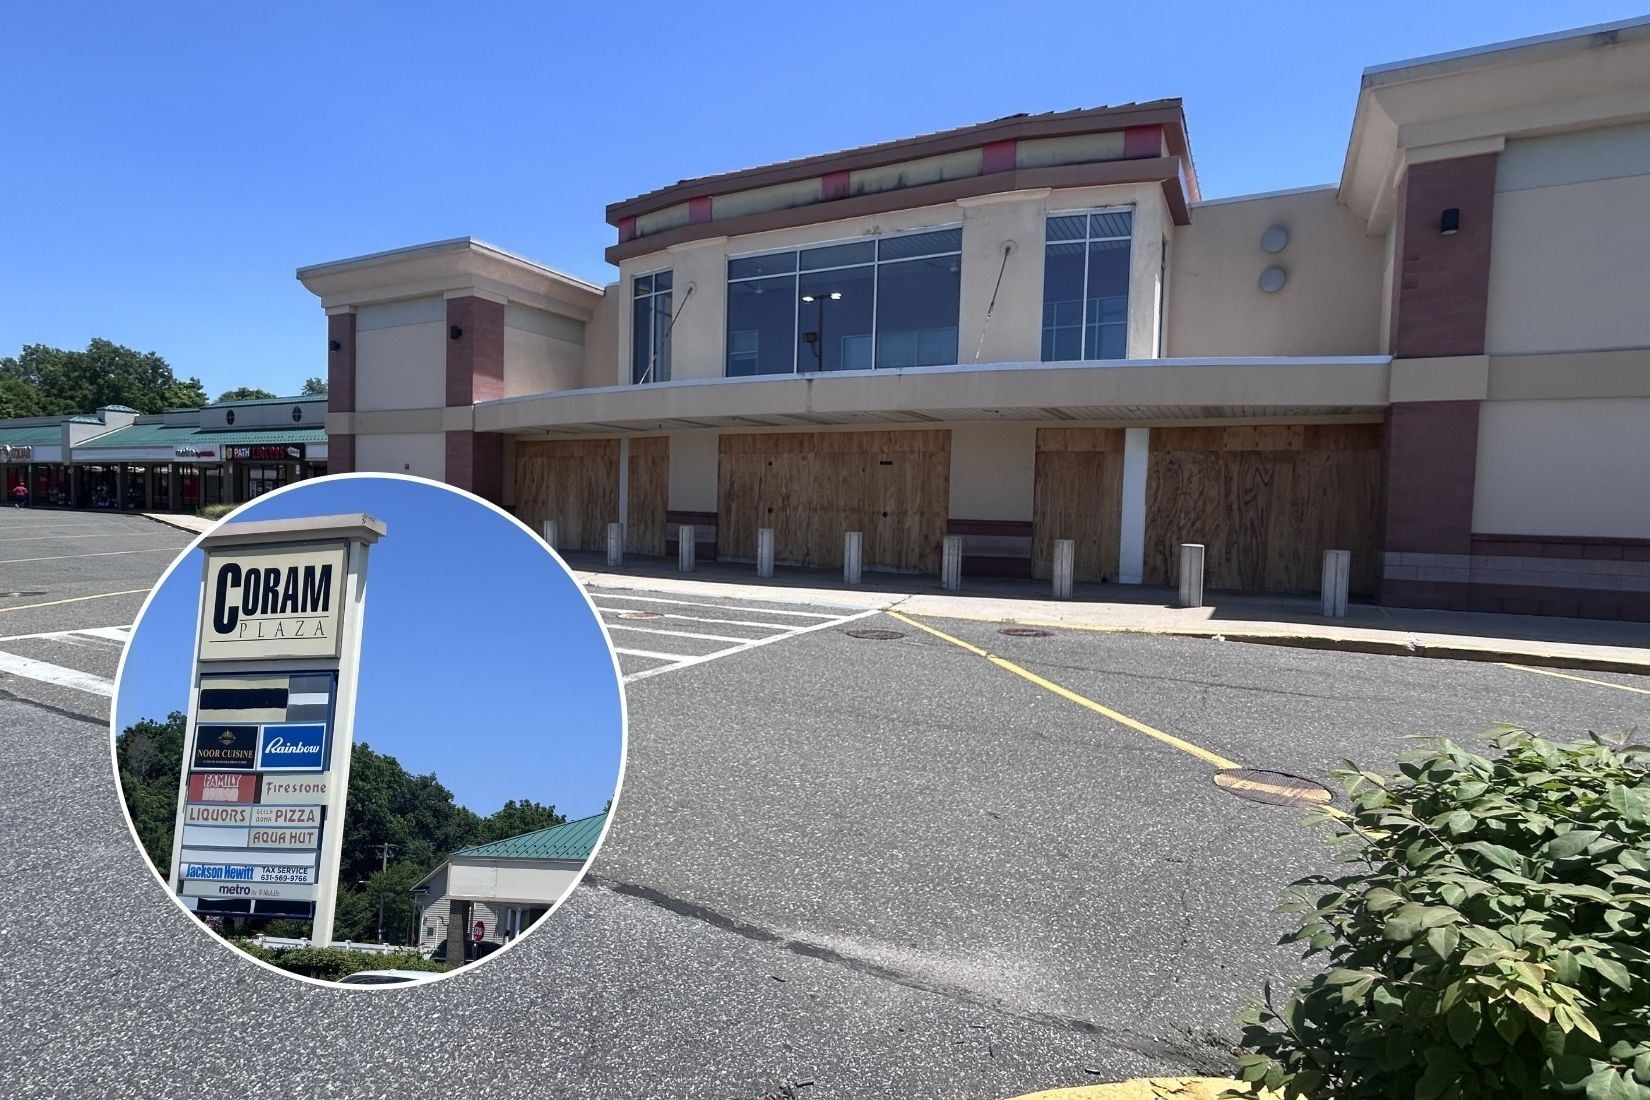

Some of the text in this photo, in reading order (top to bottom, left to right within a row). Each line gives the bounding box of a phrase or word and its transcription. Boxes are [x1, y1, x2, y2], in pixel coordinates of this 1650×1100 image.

[234, 447, 250, 457] PATH
[213, 562, 332, 634] CORAM
[239, 620, 325, 639] PLAZA
[265, 736, 319, 754] Rainbow
[197, 749, 254, 759] NOOR CUISINE
[204, 774, 241, 787] FAMILY
[265, 781, 327, 796] Firestone
[189, 807, 246, 823] LIQUORS
[275, 809, 315, 823] PIZZA
[252, 831, 315, 844] AQUA HUT
[186, 864, 255, 880] Jackson Hewitt
[277, 867, 308, 875] SERVICE
[260, 874, 308, 882] 631-569-9766
[219, 884, 250, 895] metro
